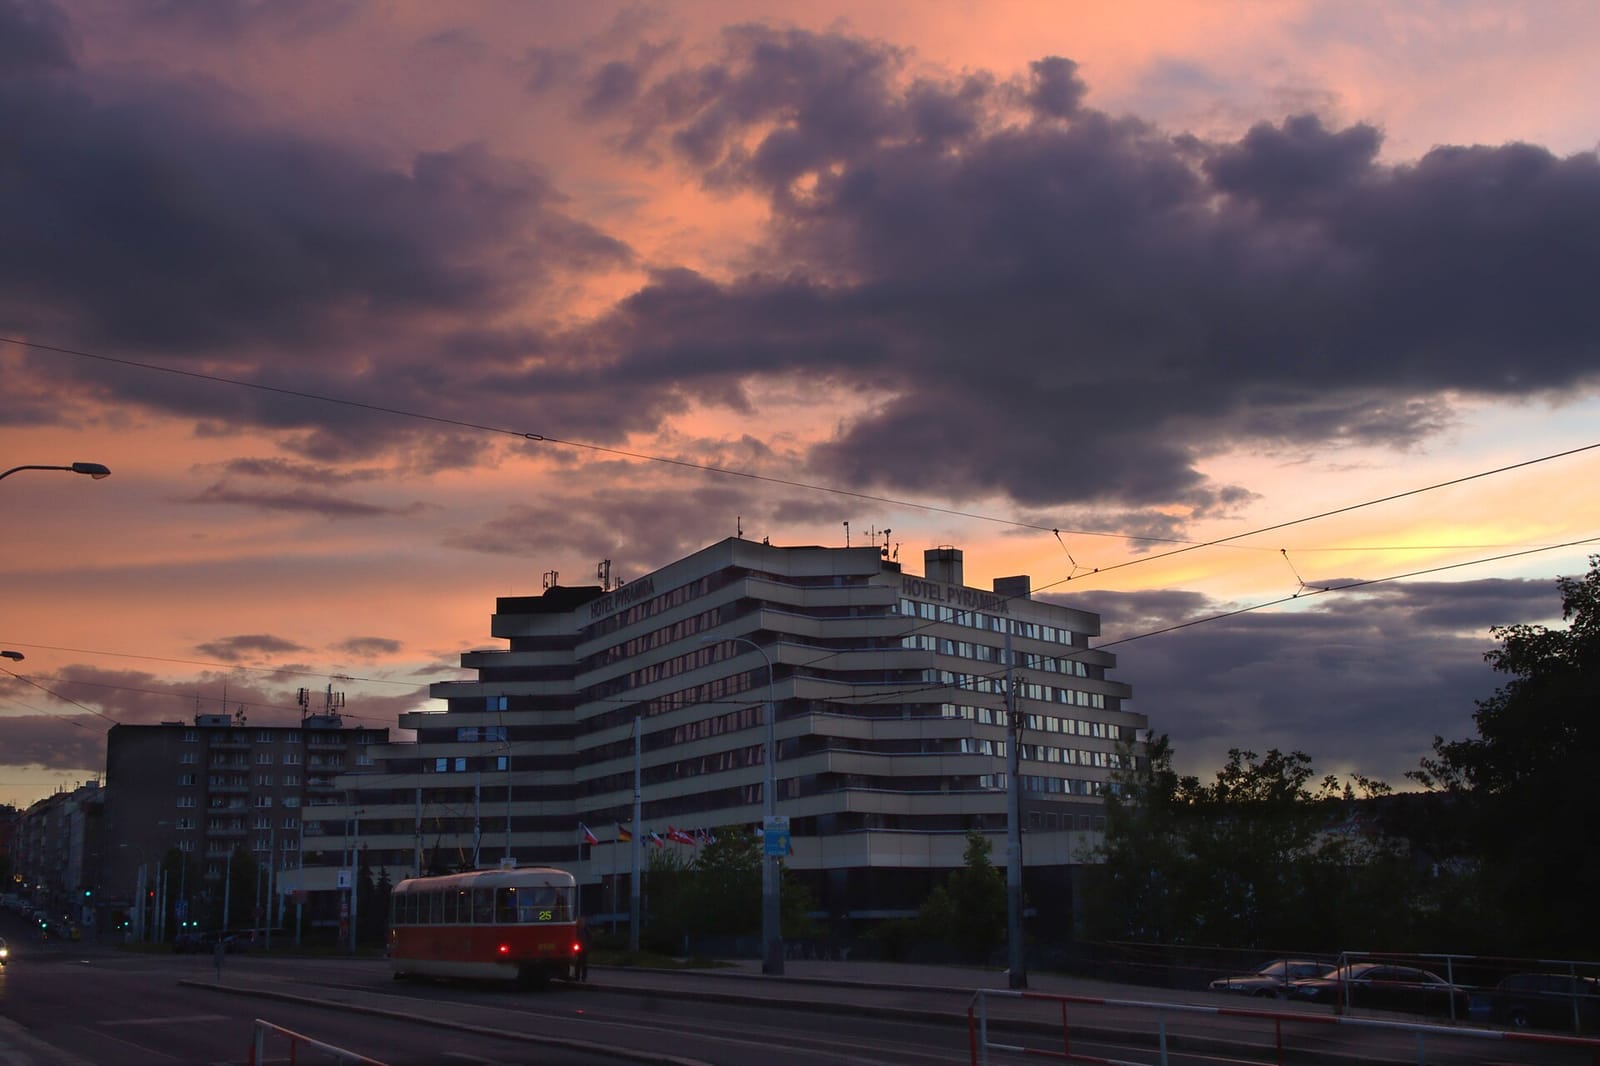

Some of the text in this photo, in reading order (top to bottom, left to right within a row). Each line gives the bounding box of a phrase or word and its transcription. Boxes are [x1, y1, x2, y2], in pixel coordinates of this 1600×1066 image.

[902, 577, 1009, 614] HOTEL PYRAMIDA
[591, 596, 614, 619] HOTEL
[538, 911, 552, 921] 25
